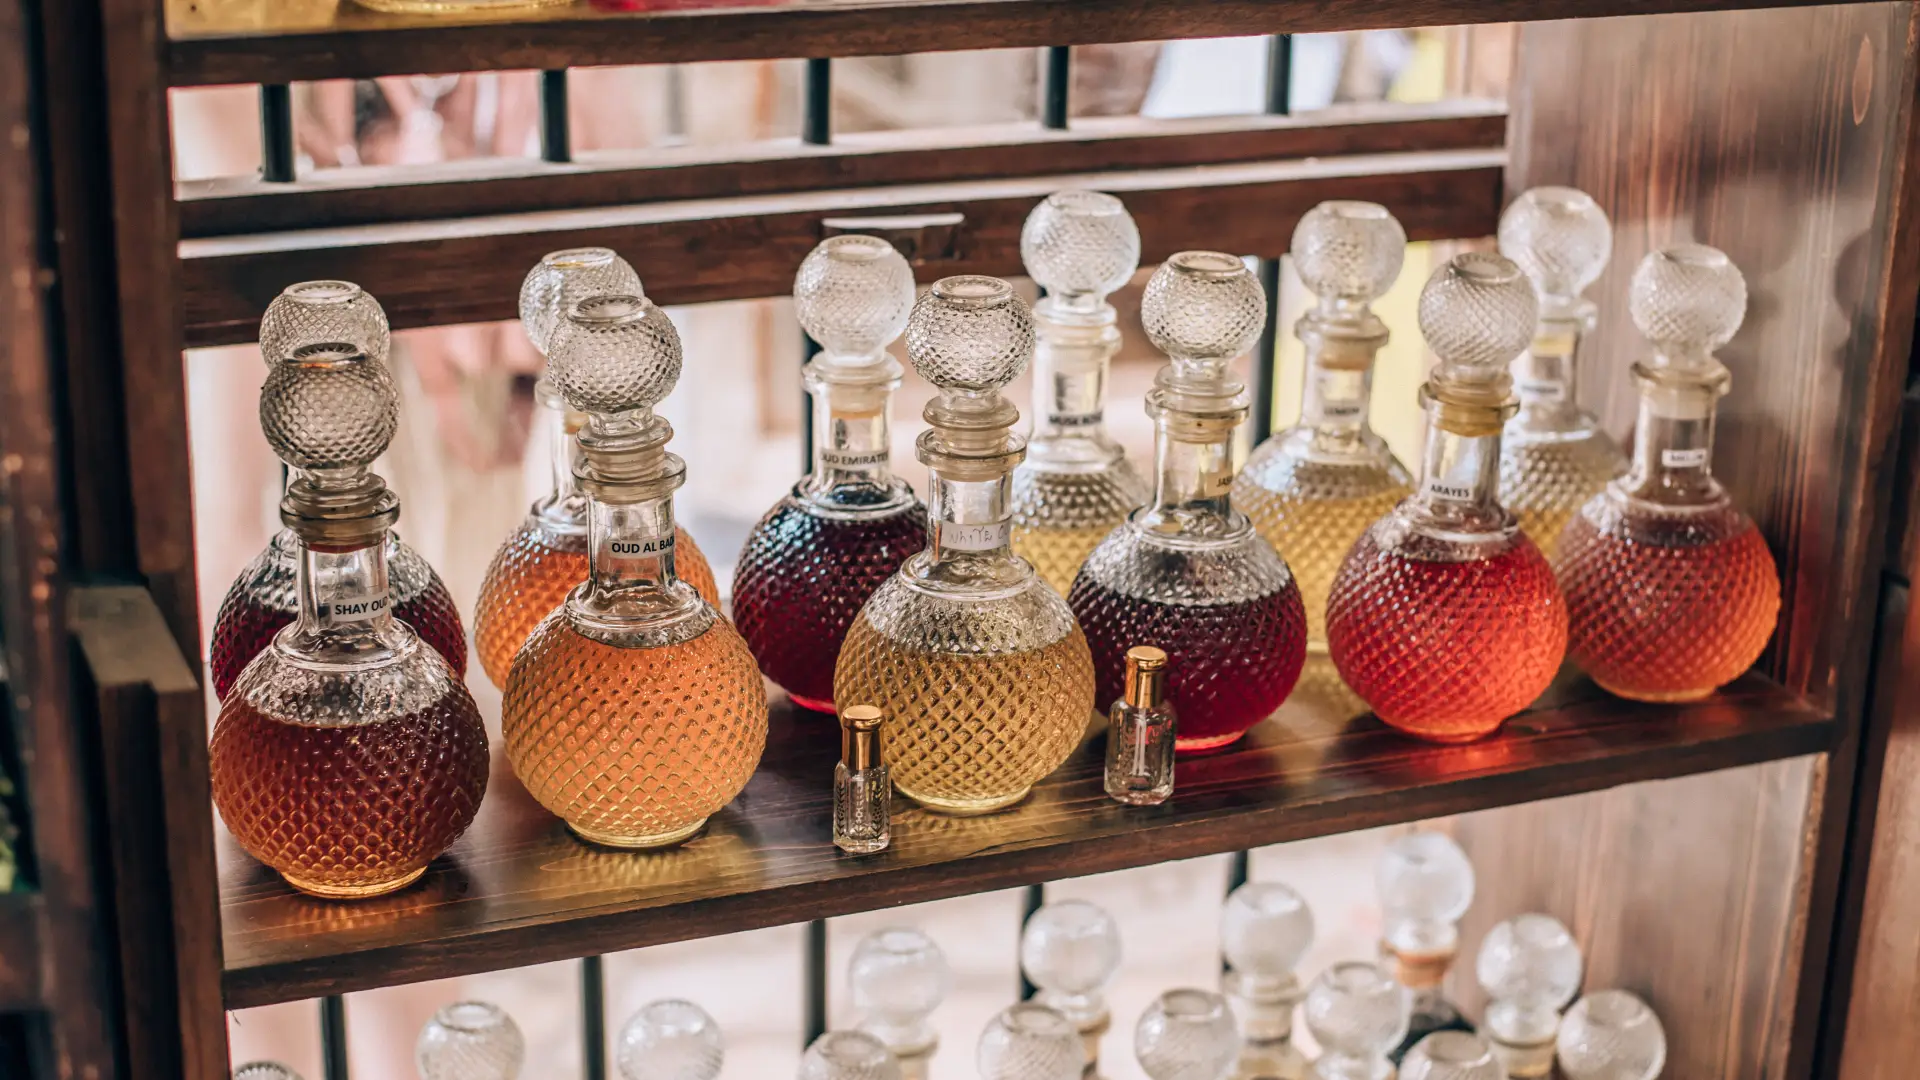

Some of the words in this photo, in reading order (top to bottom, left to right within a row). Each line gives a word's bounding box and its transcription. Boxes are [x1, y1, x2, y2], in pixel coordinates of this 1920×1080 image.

[1431, 484, 1469, 497] ARAYES
[611, 542, 640, 554] OUD
[642, 543, 657, 553] AL
[335, 602, 369, 615] SHAY
